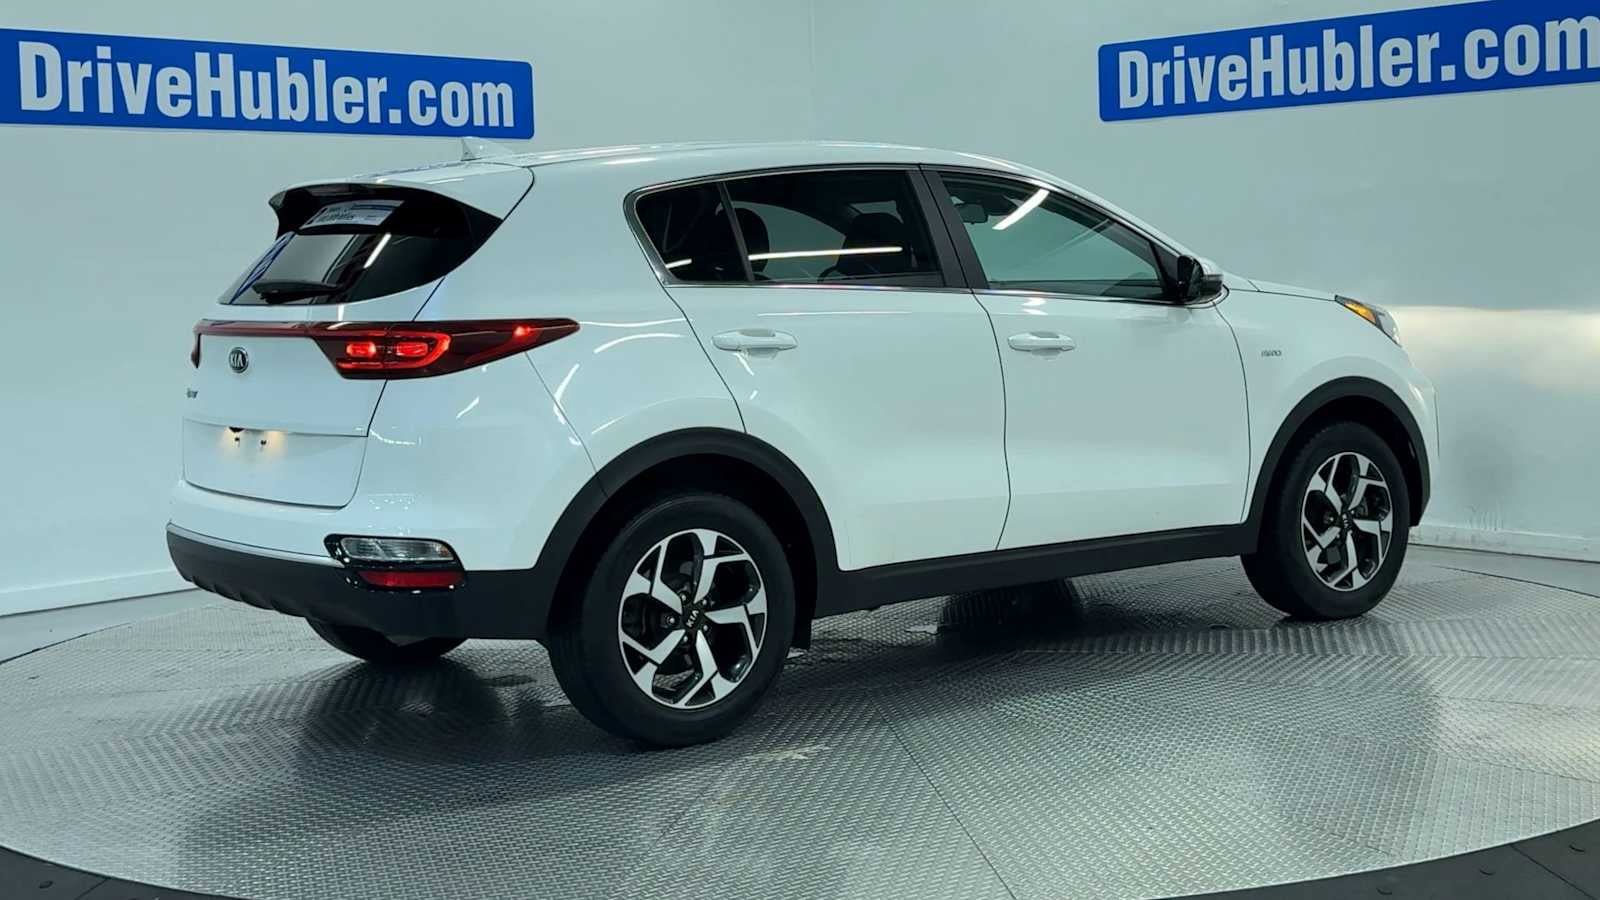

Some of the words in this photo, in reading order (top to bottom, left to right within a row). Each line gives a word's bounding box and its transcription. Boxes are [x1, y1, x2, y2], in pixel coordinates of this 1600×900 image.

[19, 41, 514, 127] DriveHubler.com
[1118, 16, 1600, 109] DriveHubler.com
[685, 609, 699, 628] KIA
